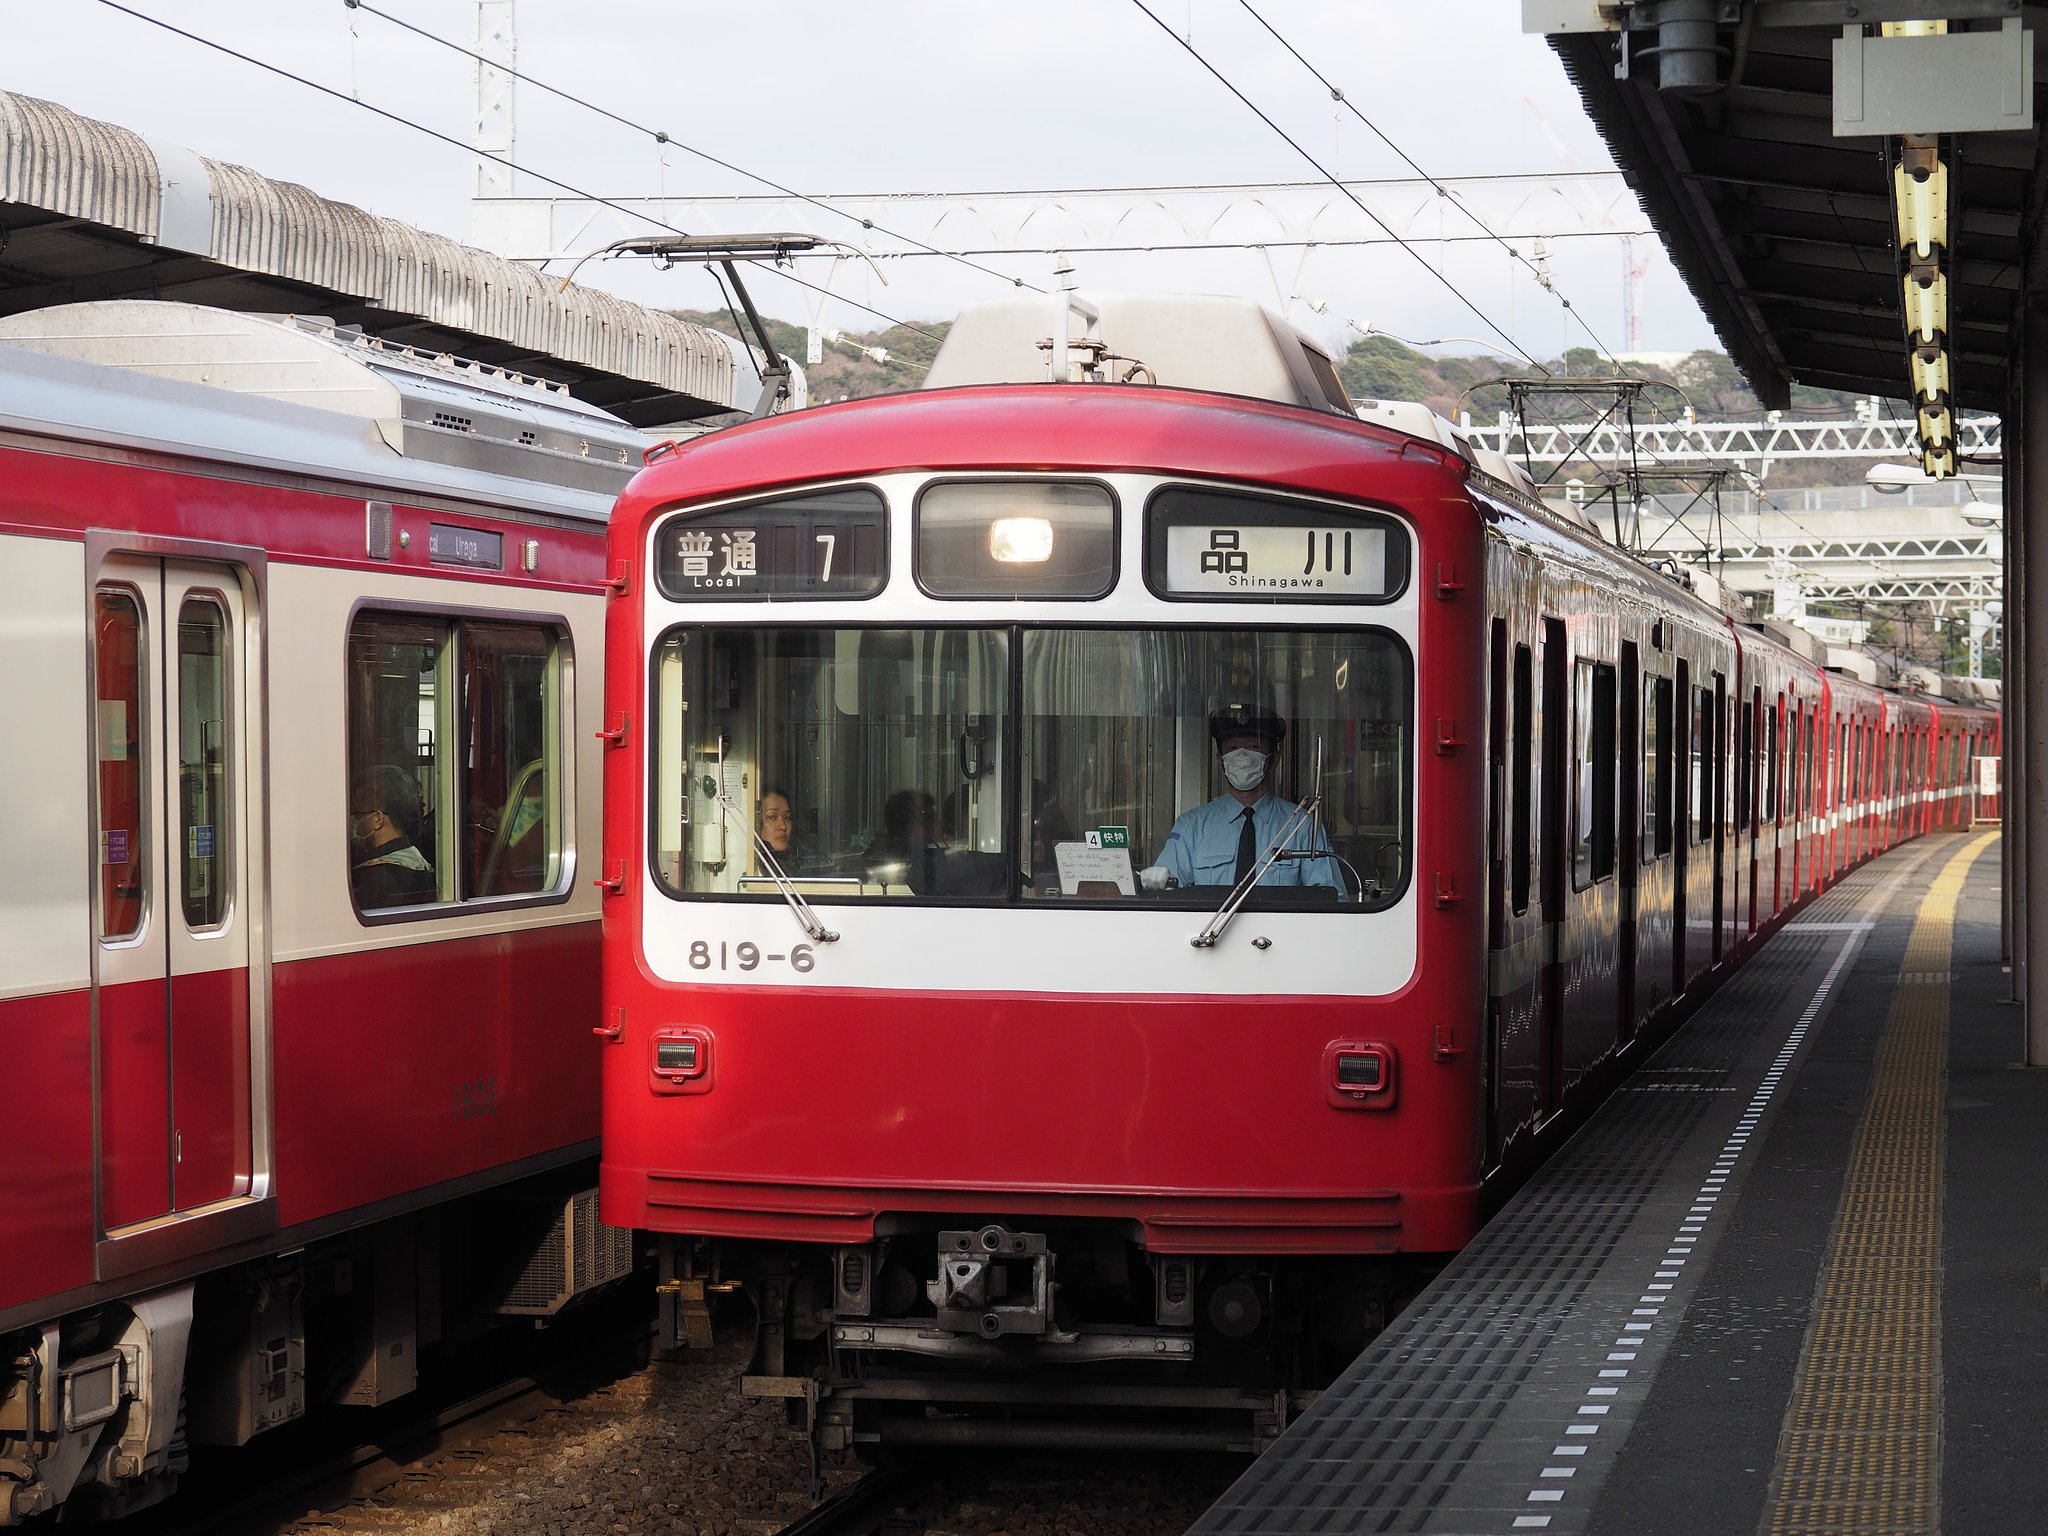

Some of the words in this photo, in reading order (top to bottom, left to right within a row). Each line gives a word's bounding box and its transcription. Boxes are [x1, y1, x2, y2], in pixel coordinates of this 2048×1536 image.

[455, 536, 478, 561] Uraga
[678, 531, 757, 576] 普通
[816, 534, 835, 582] 7
[1201, 529, 1352, 576] 品川
[694, 576, 741, 588] Local
[1228, 575, 1324, 589] Shinagawa
[1090, 834, 1098, 846] 4
[1103, 832, 1124, 843] 快特
[688, 940, 816, 974] 819-6
